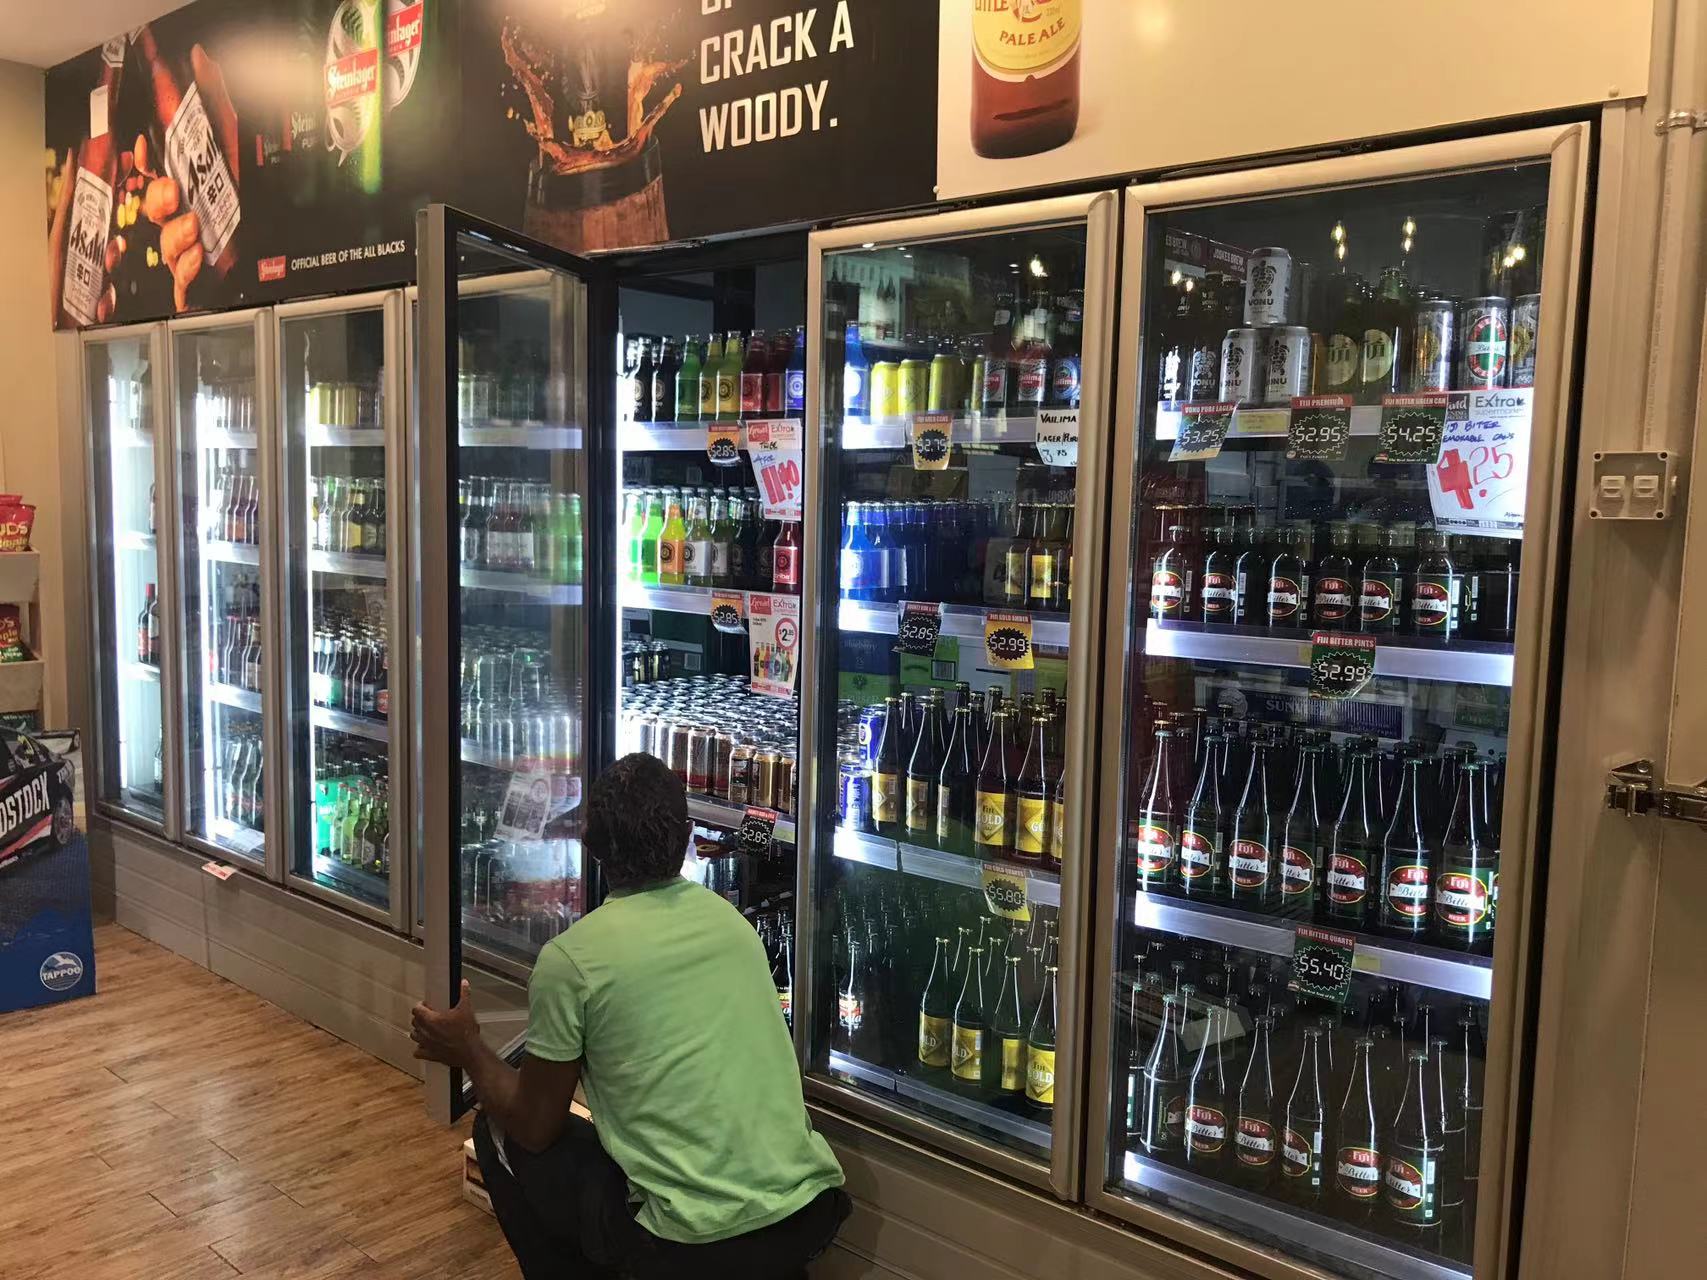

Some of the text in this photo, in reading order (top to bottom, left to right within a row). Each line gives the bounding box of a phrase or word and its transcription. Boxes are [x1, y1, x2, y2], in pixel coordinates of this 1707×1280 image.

[1000, 17, 1065, 46] PALE ALE
[700, 0, 854, 85] CRACK A
[327, 57, 376, 101] Steinlager
[699, 79, 838, 153] WOODY.
[291, 239, 406, 271] OFFICIAL BEER OF THE ALL BLACKS
[1231, 253, 1244, 264] BREW
[1248, 298, 1274, 306] VONU
[1311, 398, 1344, 407] PREMIUM
[1475, 392, 1515, 408] Extra
[1040, 413, 1077, 424] VAILIMA
[1182, 427, 1220, 446] $3.25
[1295, 425, 1342, 444] $2.95
[1387, 424, 1436, 445] $4.25
[713, 610, 739, 625] $2.85
[901, 624, 934, 641] $2.85
[989, 633, 1026, 652] $2.99
[1316, 636, 1375, 648] FIJI BITTER PINTS
[1318, 661, 1367, 682] $2.99
[742, 825, 768, 844] $2.85
[1407, 869, 1424, 880] Fiji
[1451, 877, 1469, 889] Fiji
[988, 883, 1022, 905] $5.80
[1308, 931, 1329, 941] BITTER
[1329, 934, 1353, 946] QUARTS
[42, 966, 81, 981] TAPPOO
[1299, 954, 1345, 980] $5.40
[1192, 1124, 1217, 1137] Bitter
[1241, 1136, 1265, 1150] Bitter
